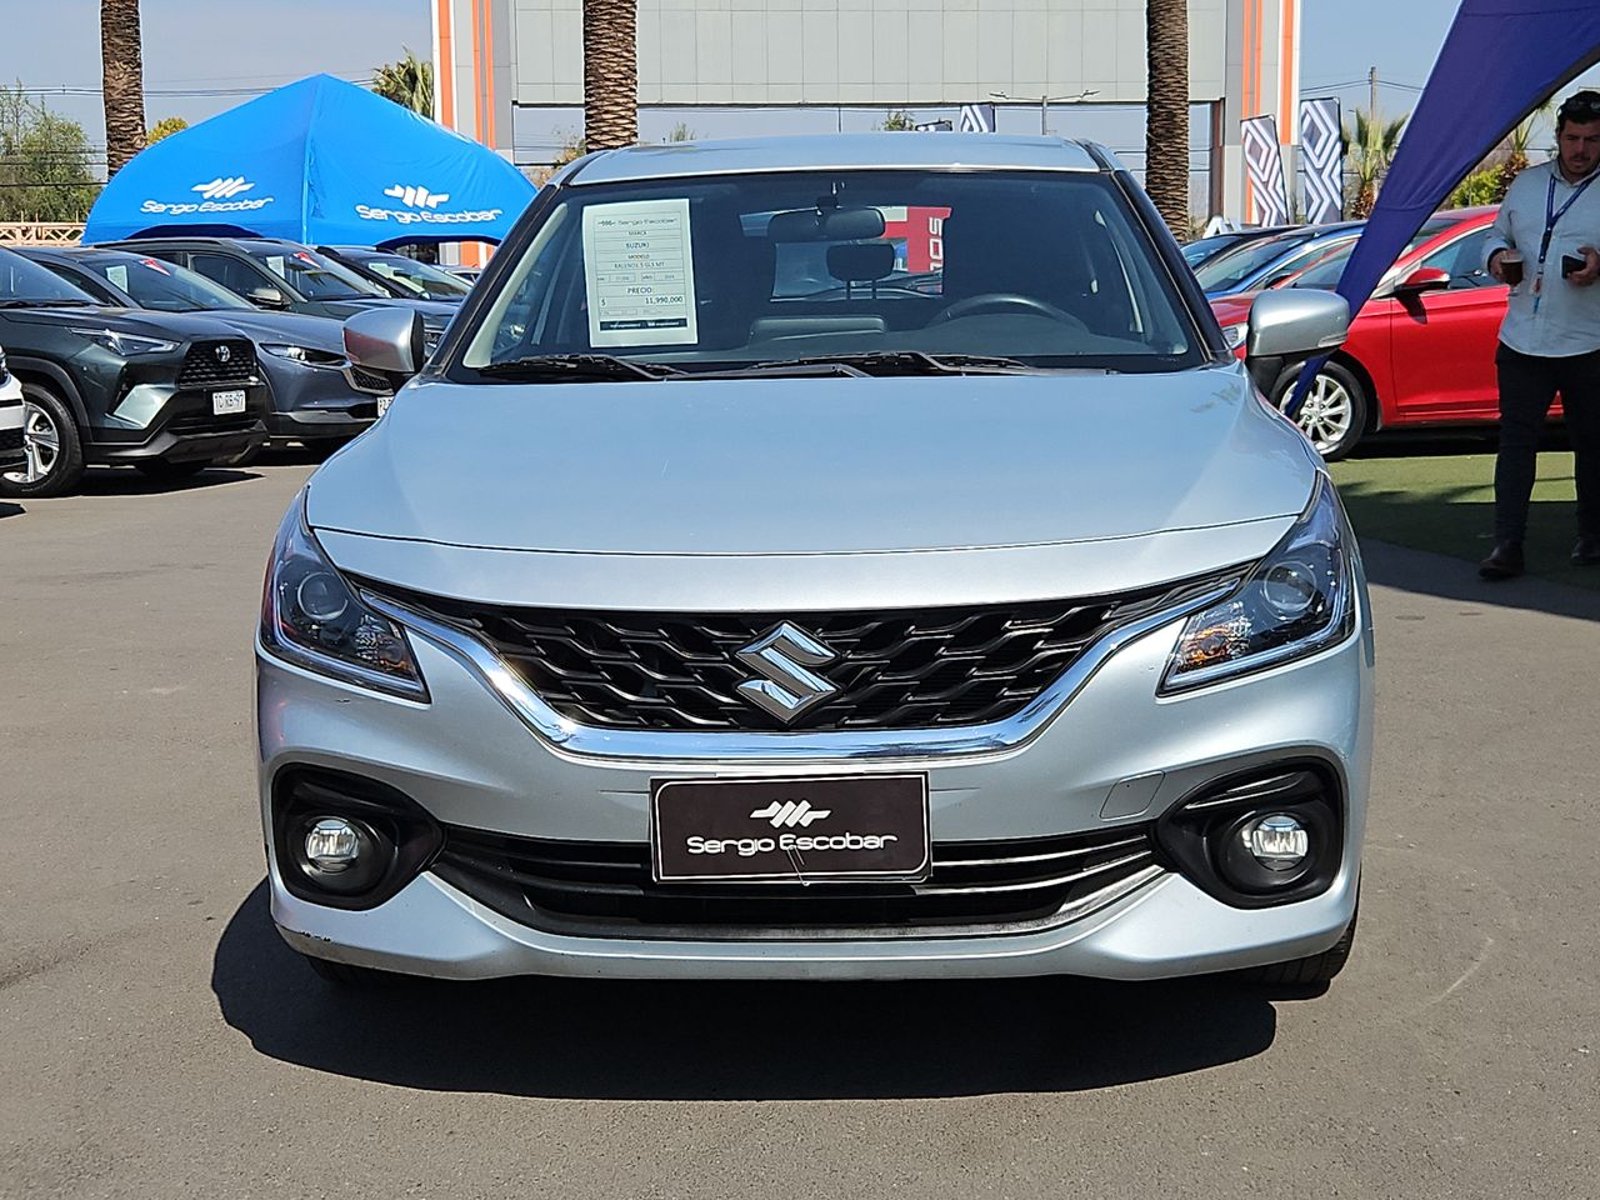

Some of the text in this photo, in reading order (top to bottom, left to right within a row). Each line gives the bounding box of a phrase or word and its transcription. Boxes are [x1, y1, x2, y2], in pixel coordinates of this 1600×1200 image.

[198, 197, 274, 212] Escobar
[420, 208, 503, 224] Escobar
[626, 286, 653, 295] PRECIO
[600, 298, 606, 307] $
[686, 831, 898, 857] Sergio Escobar
